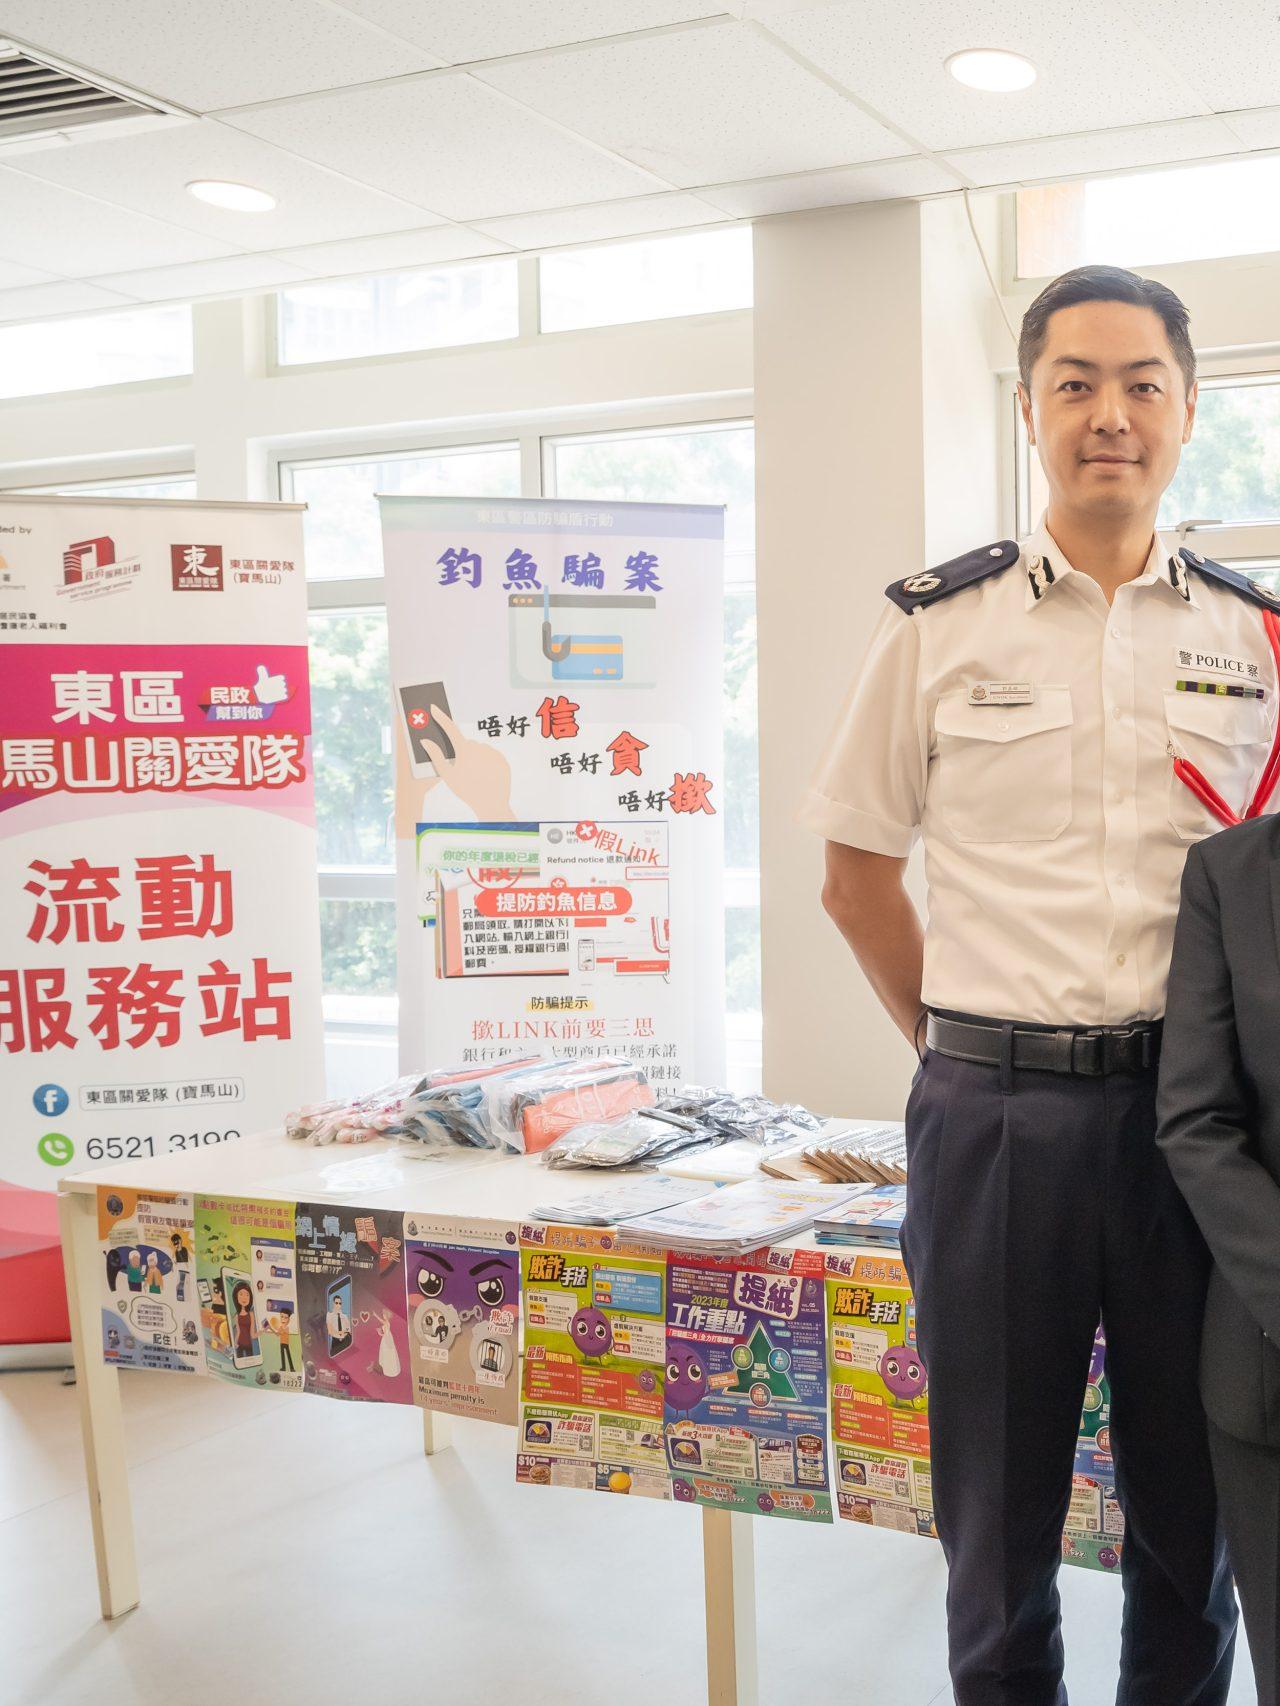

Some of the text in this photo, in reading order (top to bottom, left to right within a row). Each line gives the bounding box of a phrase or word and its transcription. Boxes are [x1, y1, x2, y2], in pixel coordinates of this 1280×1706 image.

[182, 546, 220, 576] 東
[436, 547, 664, 592] 釣魚騙案
[1195, 653, 1245, 673] POLICE
[50, 669, 185, 724] 東區
[210, 686, 250, 705] 民政
[22, 854, 235, 945] 流動
[496, 892, 618, 912] 提防釣魚信息
[0, 957, 293, 1054] 服務站
[530, 996, 589, 1011] 防騙提示
[85, 1136, 155, 1160] 6521
[739, 1273, 795, 1317] 提紙
[668, 1303, 747, 1335] 工作重點
